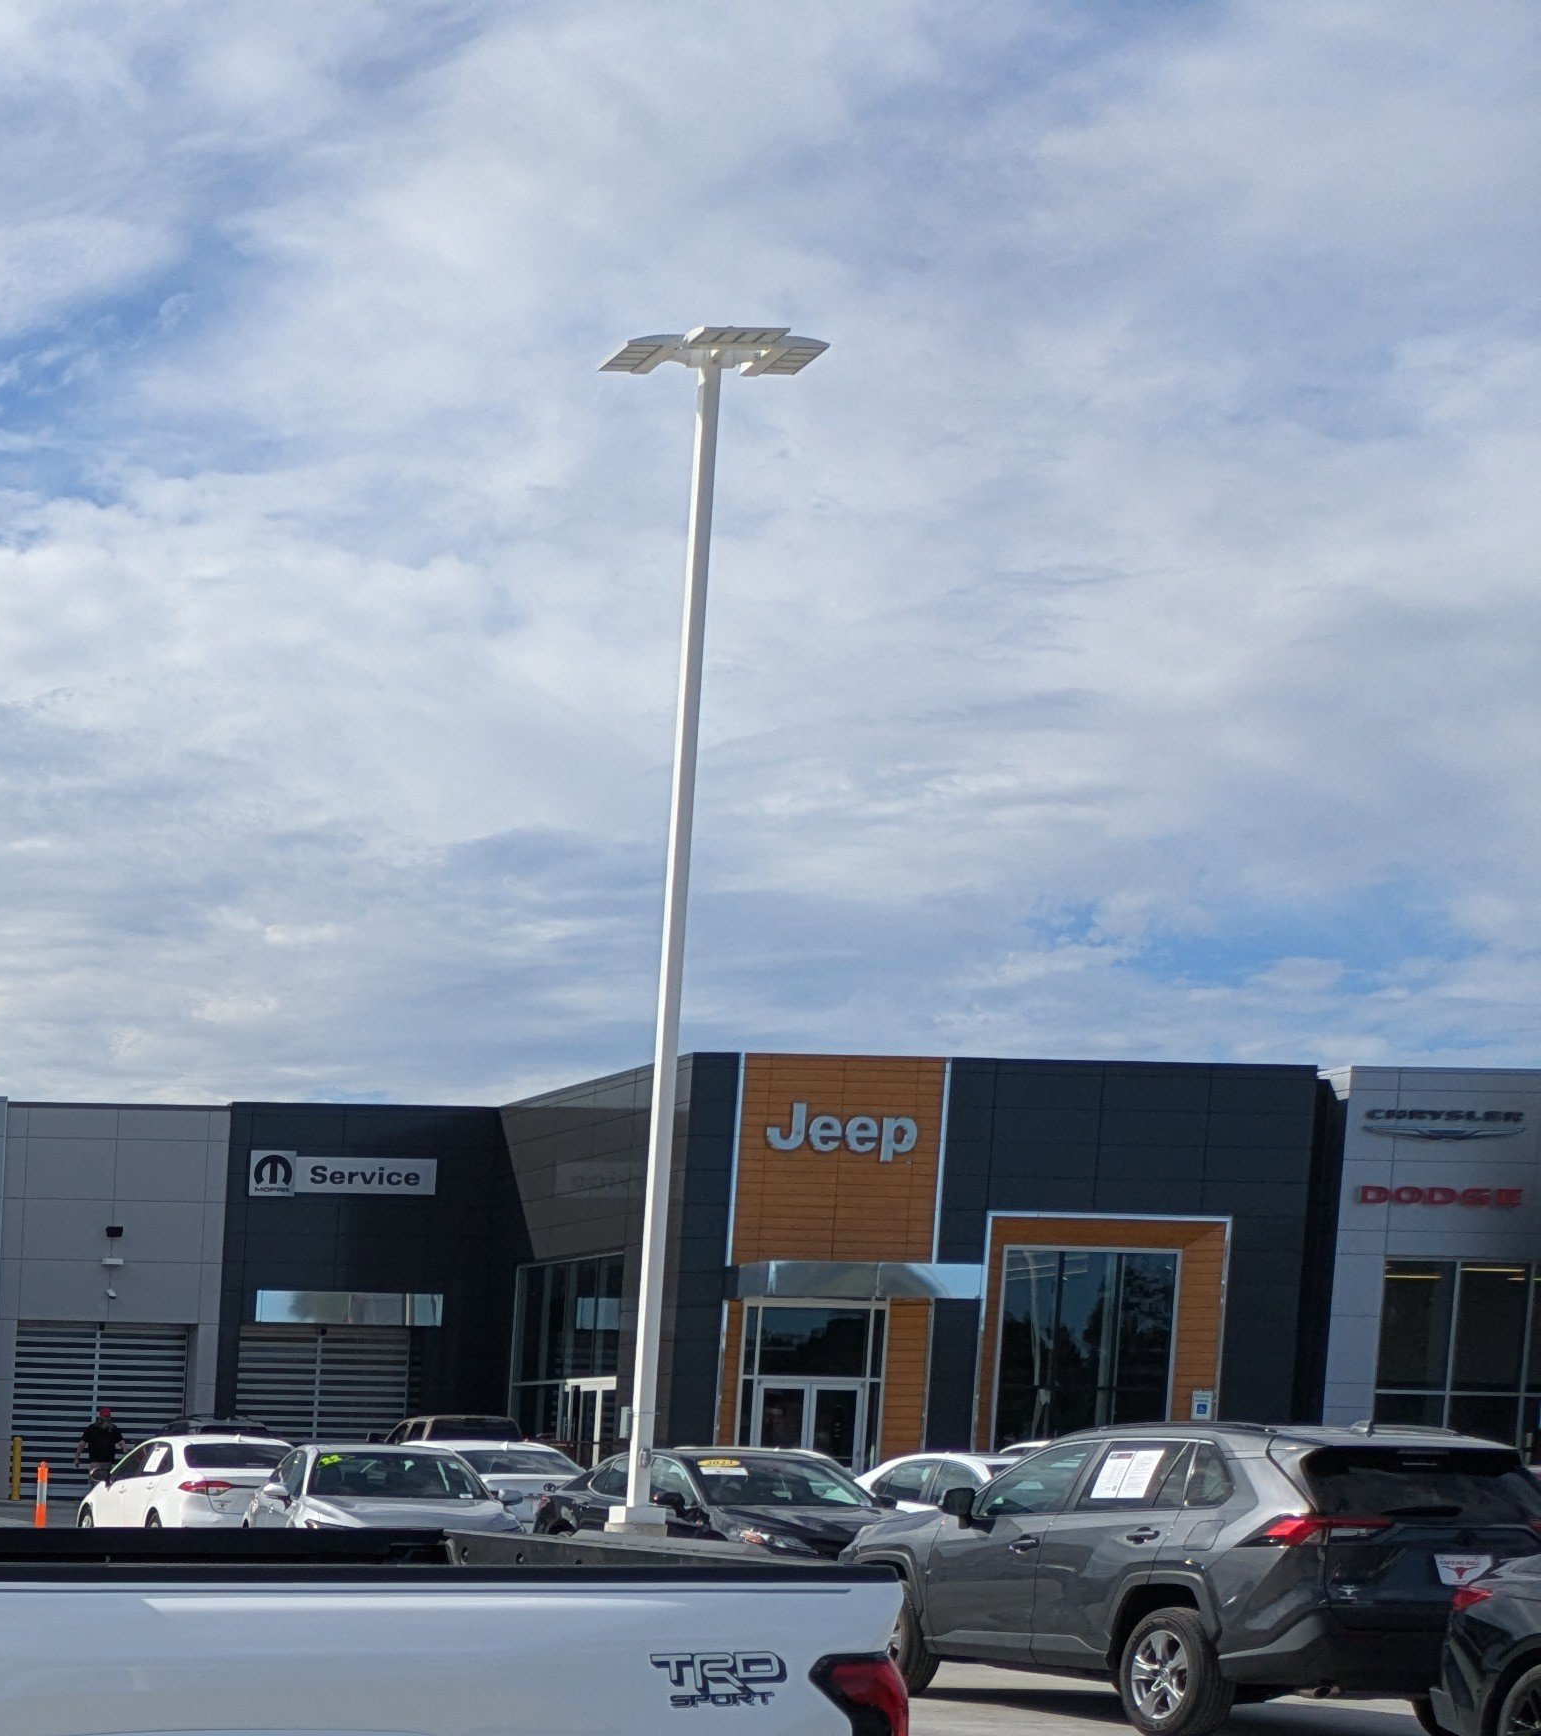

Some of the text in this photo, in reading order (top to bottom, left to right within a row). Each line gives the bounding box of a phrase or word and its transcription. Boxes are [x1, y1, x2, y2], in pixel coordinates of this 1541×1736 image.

[1366, 1109, 1525, 1122] CHRYSLER
[765, 1101, 918, 1162] Jeep
[309, 1155, 421, 1187] Service
[1360, 1185, 1524, 1207] DODGE
[649, 1651, 788, 1697] TRD
[669, 1691, 776, 1708] SPORT
